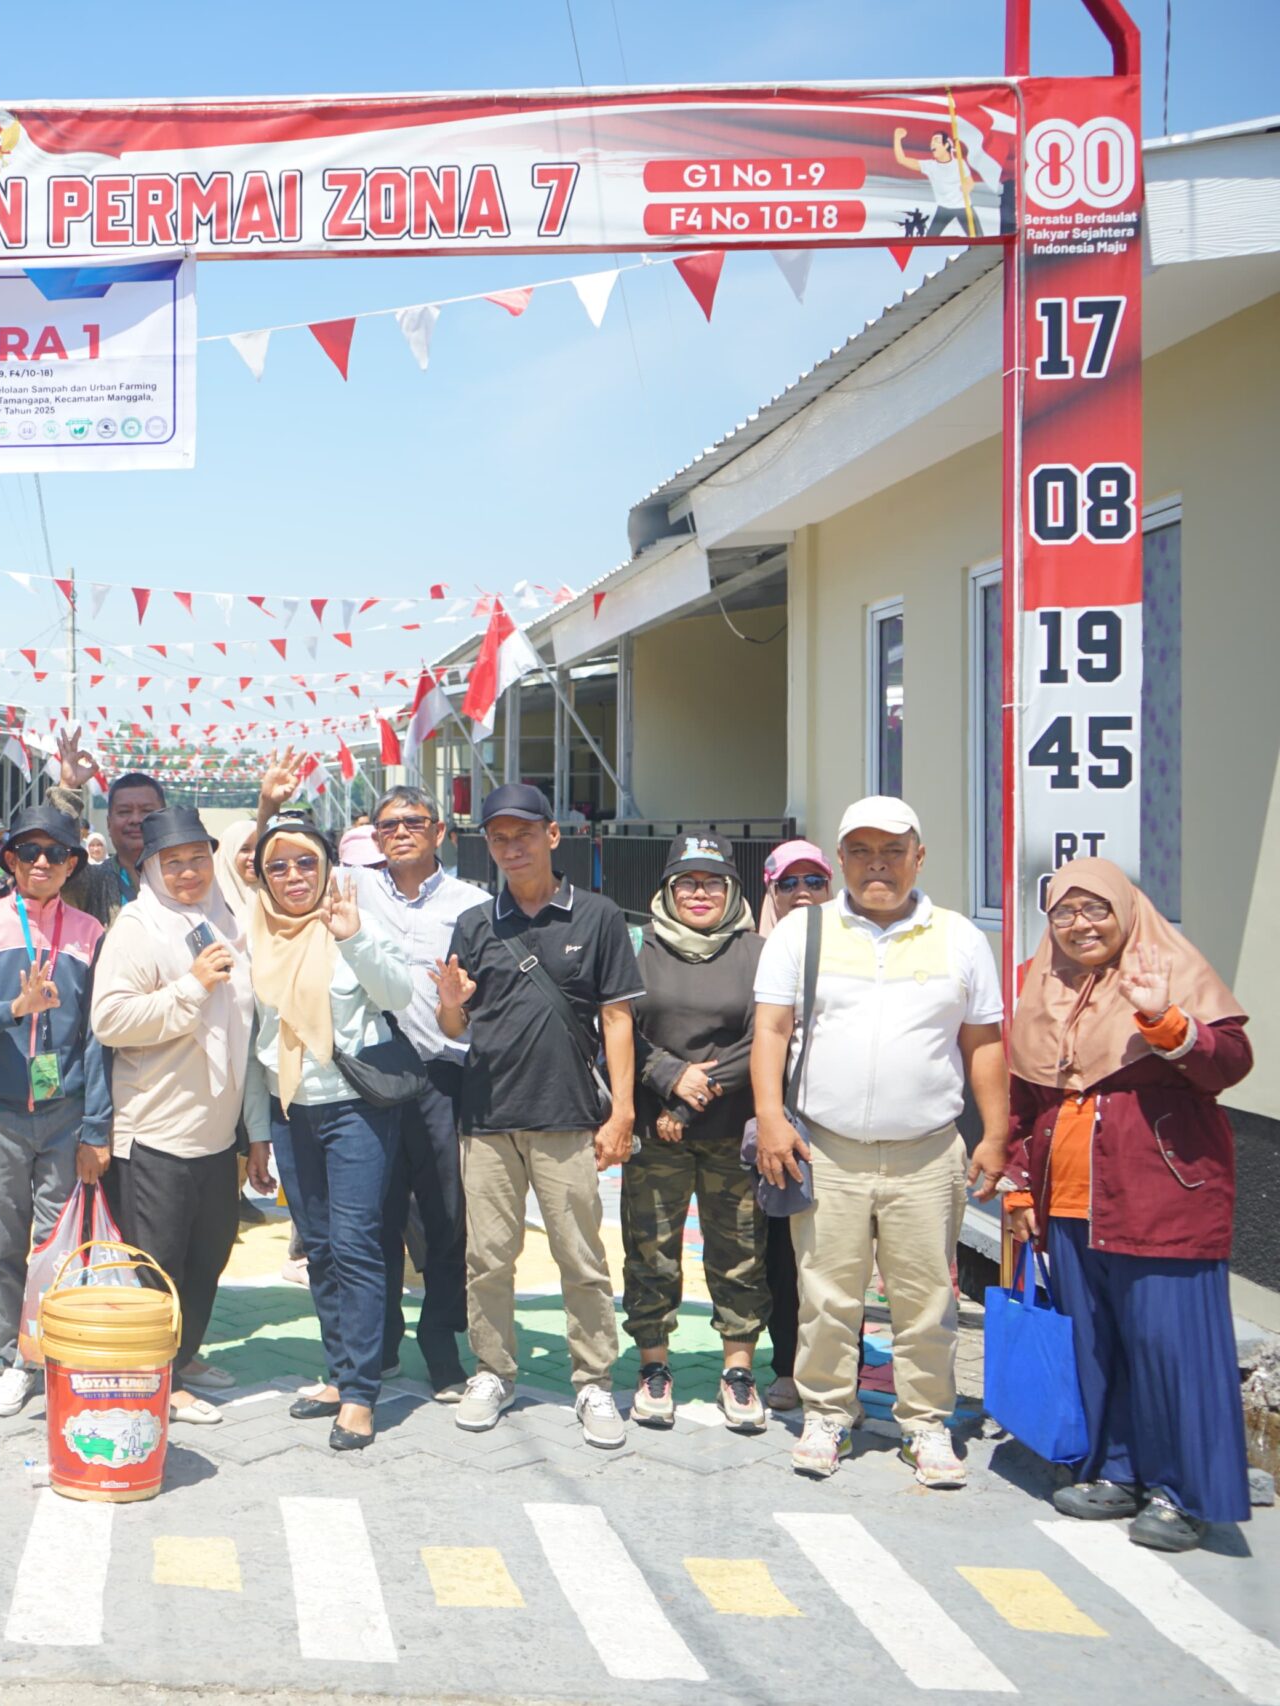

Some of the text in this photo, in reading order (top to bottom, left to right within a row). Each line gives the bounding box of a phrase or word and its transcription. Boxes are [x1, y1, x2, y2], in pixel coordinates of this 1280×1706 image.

[683, 163, 825, 188] G1 No 1-9
[1024, 116, 1135, 210] 80
[47, 169, 302, 248] PERMAI
[322, 164, 510, 242] ZONA
[532, 163, 580, 239] 7
[670, 205, 839, 231] F4 No 10-18
[1024, 211, 1138, 225] Bersatu Berdaulat
[1072, 227, 1135, 241] Sejahtera
[1033, 241, 1128, 255] Indonesia Maju
[83, 324, 100, 360] 1
[1035, 296, 1127, 380] 17
[32, 385, 68, 394] Sampah
[70, 384, 87, 392] dan
[89, 383, 117, 392] Urban
[119, 382, 157, 392] Farming
[54, 395, 104, 403] Kecamatan
[4, 407, 31, 415] Tahun
[34, 406, 55, 414] 2025
[1028, 462, 1137, 546] 08
[1038, 609, 1122, 684] 19
[1028, 716, 1133, 789] 45
[70, 1374, 118, 1389] ROYAL
